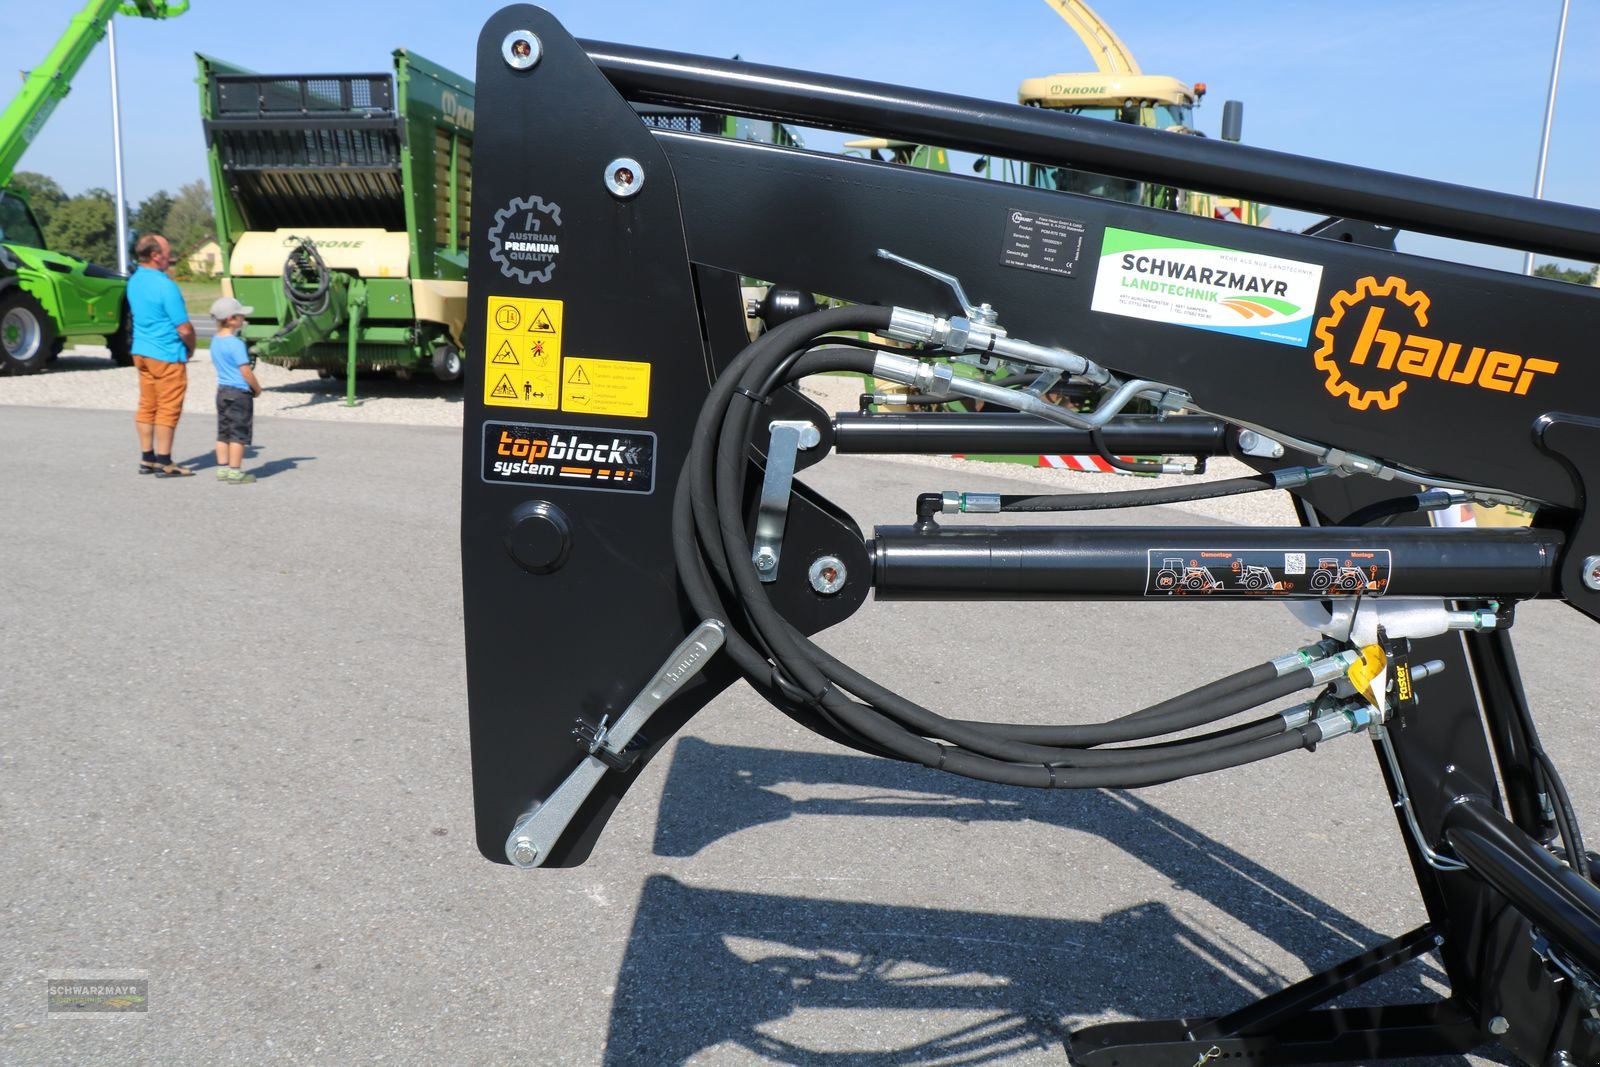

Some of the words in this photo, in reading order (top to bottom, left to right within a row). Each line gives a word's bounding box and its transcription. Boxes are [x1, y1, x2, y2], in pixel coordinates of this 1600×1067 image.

[1062, 86, 1107, 95] KRONE
[508, 232, 557, 242] AUSTRIAN
[504, 241, 560, 253] PREMIUM
[509, 252, 554, 262] QUALITY
[1121, 253, 1289, 297] SCHWARZMAYR
[1268, 262, 1314, 276] LANDTECHNIK
[1121, 276, 1219, 303] LANDTECHNIK
[1349, 305, 1560, 396] hauer
[493, 460, 556, 477] system
[1396, 665, 1409, 701] Faster
